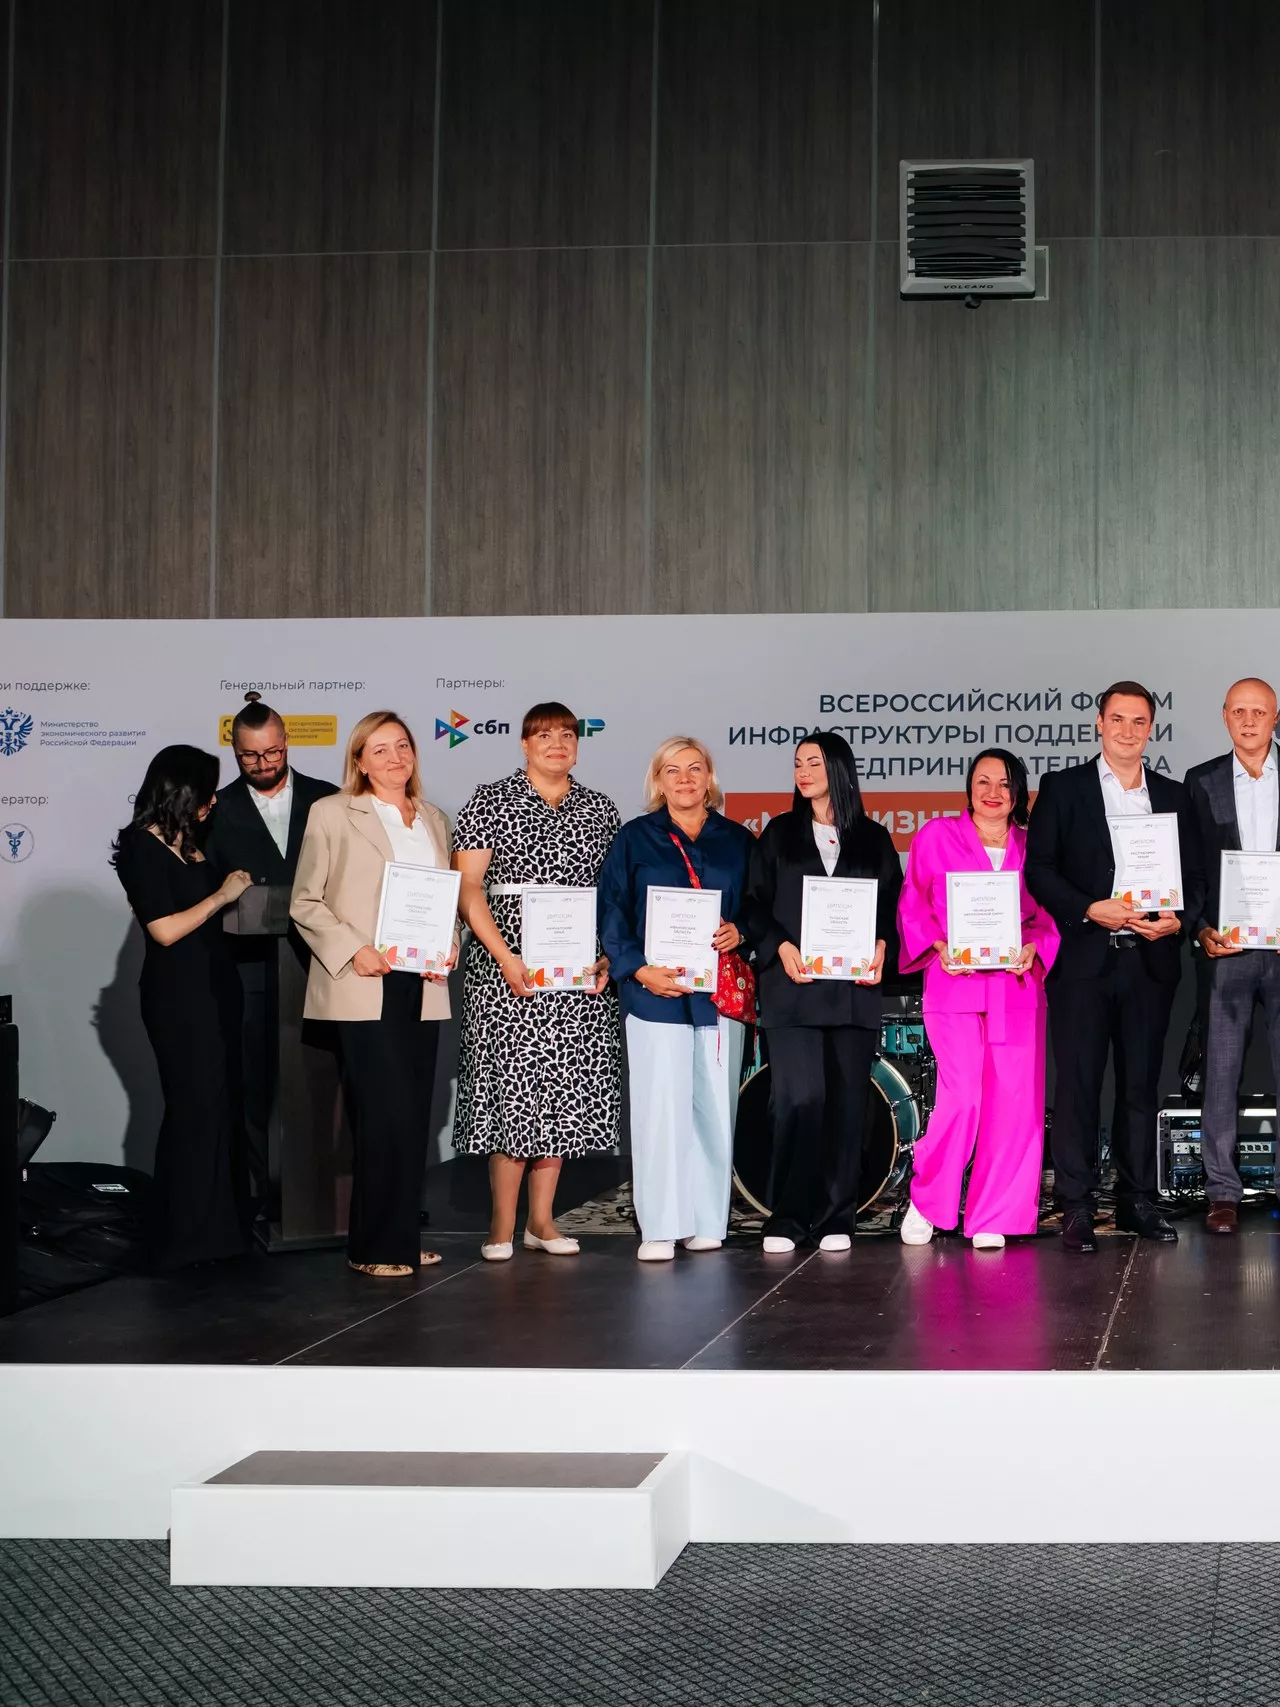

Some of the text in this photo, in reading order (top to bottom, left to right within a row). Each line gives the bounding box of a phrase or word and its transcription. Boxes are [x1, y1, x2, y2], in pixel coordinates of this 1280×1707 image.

[15, 681, 91, 692] поддержке:
[220, 680, 366, 692] Генеральный партнер:
[436, 678, 505, 690] Партнеры:
[819, 688, 1062, 713] ВСЕРОССИЙСКИЙ
[473, 719, 510, 735] сбп
[109, 730, 146, 738] развития
[995, 724, 1173, 747] ПОДДЕИ
[40, 738, 137, 747] Российской Федерации
[1, 796, 49, 806] ератор:
